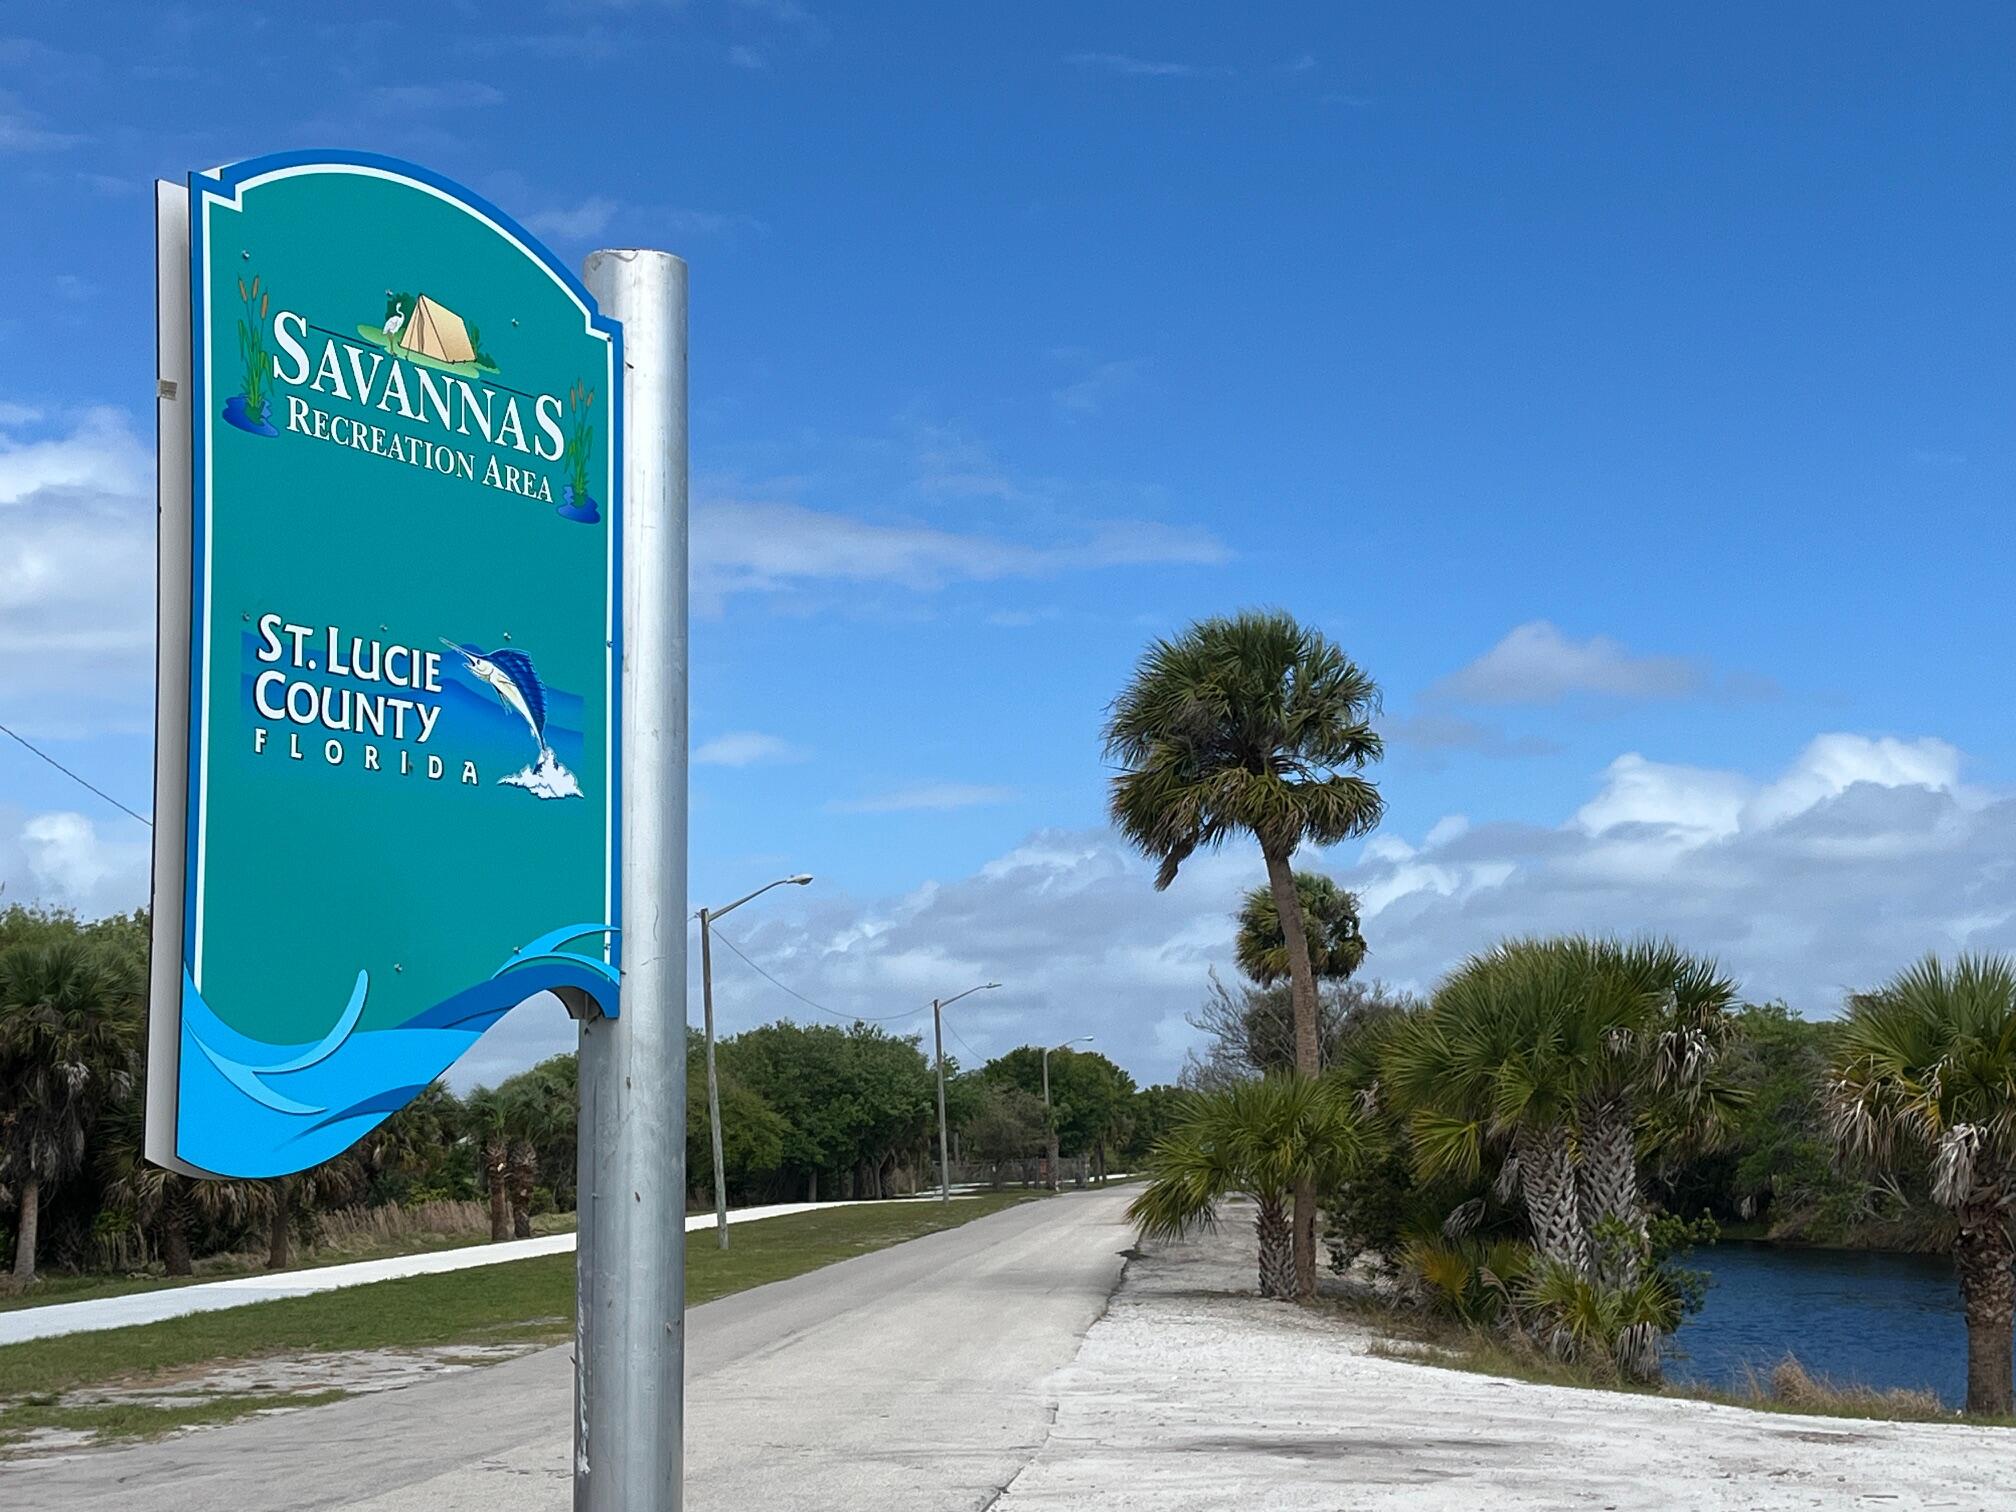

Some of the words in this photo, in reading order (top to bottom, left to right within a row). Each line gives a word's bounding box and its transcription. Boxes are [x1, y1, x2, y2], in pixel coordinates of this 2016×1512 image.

[273, 311, 564, 461] SAVANNAS
[286, 395, 476, 481] RECREATION
[482, 454, 553, 503] AREA
[258, 613, 316, 669] ST.
[328, 625, 442, 693] LUCIE
[255, 670, 442, 742] COUNTY
[254, 728, 479, 785] FLORIDA
